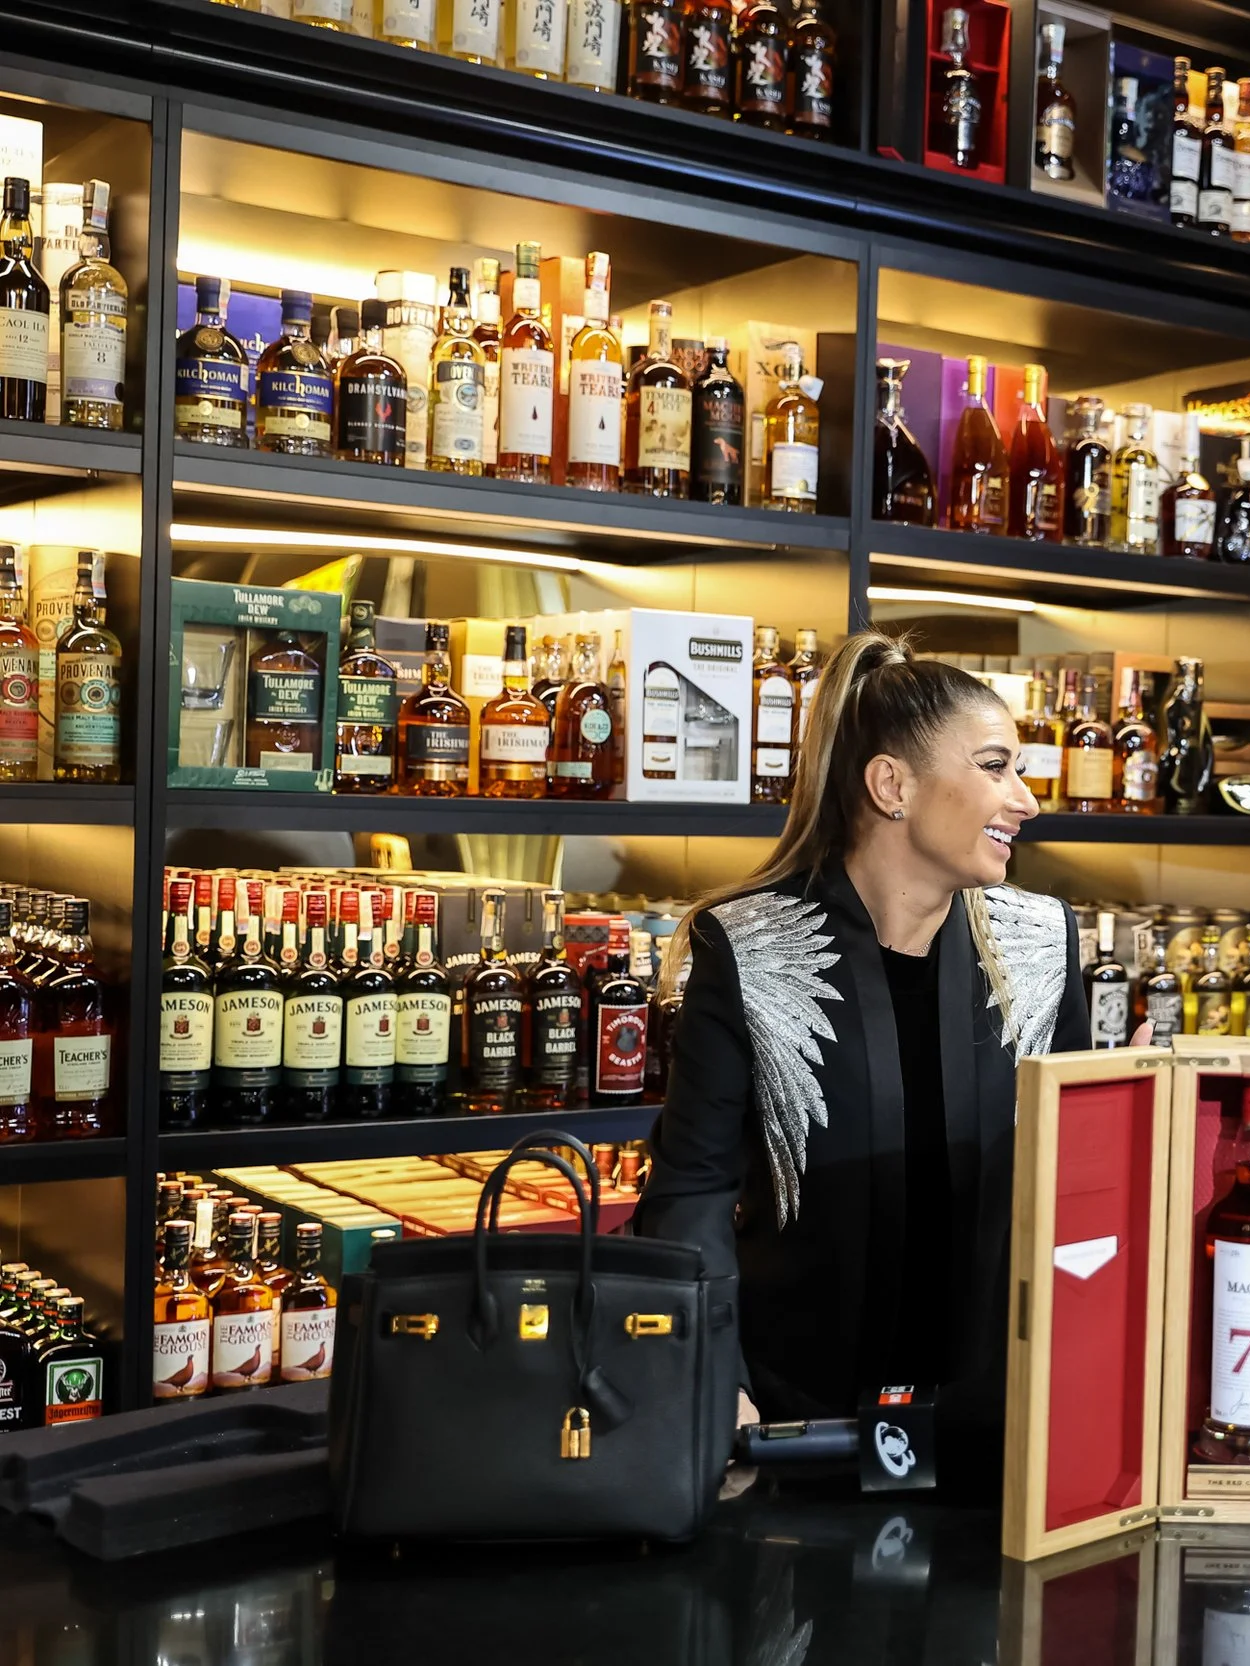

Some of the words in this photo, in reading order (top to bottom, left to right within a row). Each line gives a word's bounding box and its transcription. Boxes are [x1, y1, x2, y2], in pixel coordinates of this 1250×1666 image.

[19, 334, 29, 344] 12
[97, 352, 106, 363] 8
[233, 589, 284, 608] TULLAMORE
[36, 601, 73, 618] PROVE
[248, 604, 269, 616] DEW
[691, 641, 742, 659] BUSHMILLS
[262, 675, 314, 691] TULLAMORE
[341, 680, 391, 696] TULLAMORE
[278, 691, 300, 700] DEW
[357, 695, 378, 705] DEW
[430, 731, 447, 739] THE
[222, 997, 281, 1013] JAMESON
[486, 1031, 515, 1044] BLACK
[549, 1028, 576, 1039] BLACK
[483, 1046, 516, 1058] BARREL
[545, 1042, 577, 1054] BARREL
[58, 1050, 108, 1065] TEACHER'S
[229, 1320, 272, 1336] FAMOUS
[294, 1318, 336, 1333] FAMOUS
[160, 1330, 207, 1346] FAMOUS
[228, 1332, 272, 1346] GROUSE
[293, 1330, 335, 1342] GROUSE
[159, 1343, 206, 1355] GROUSE
